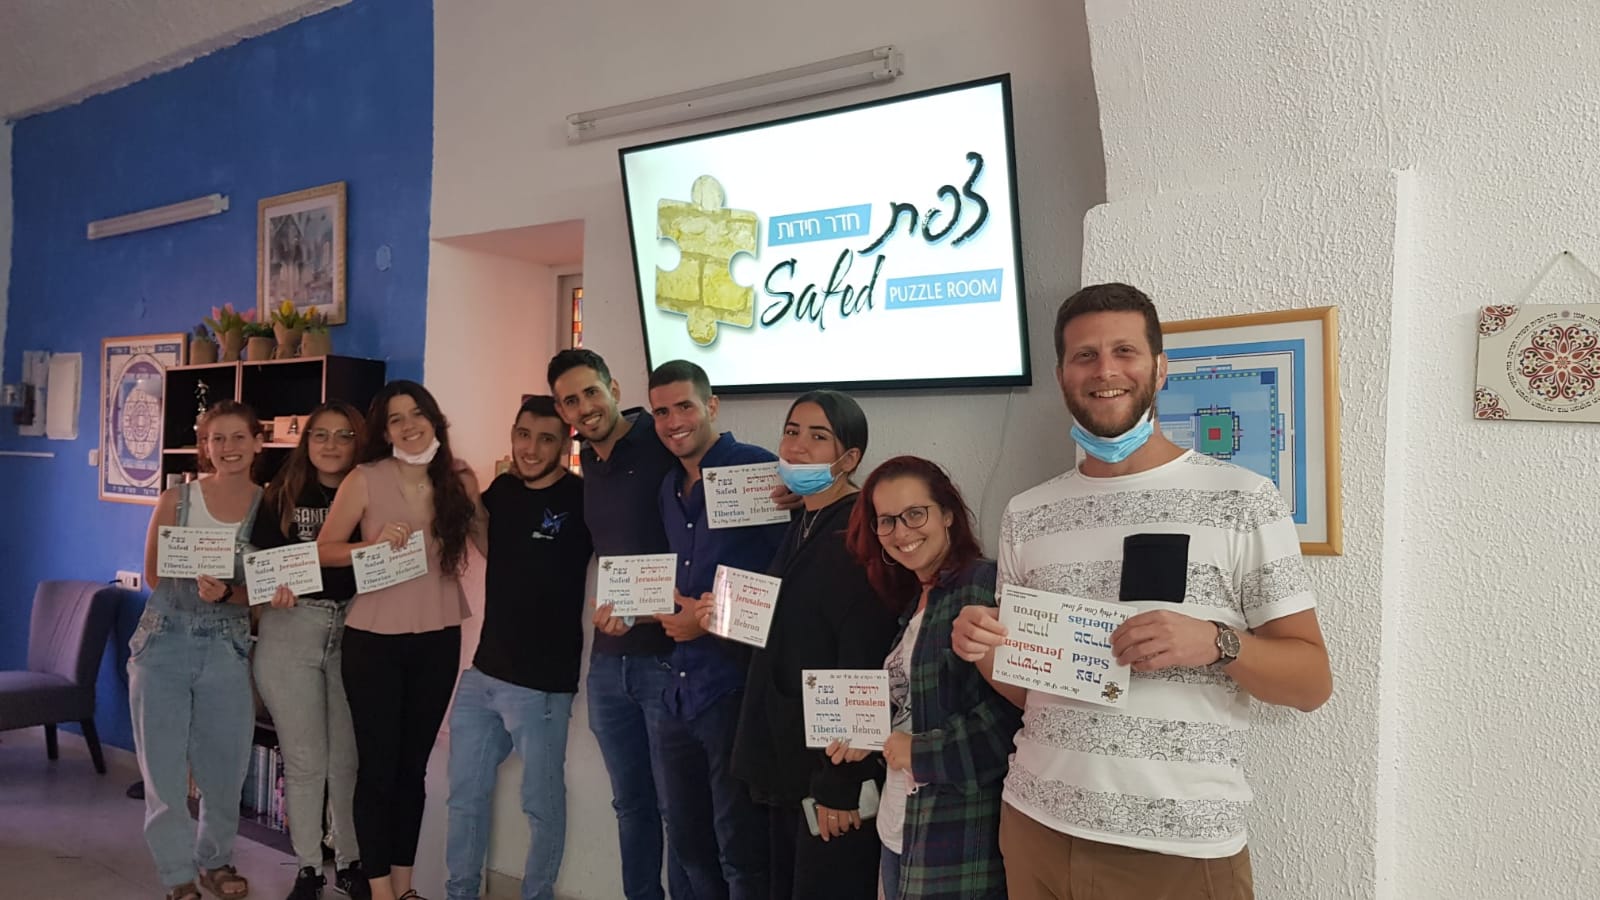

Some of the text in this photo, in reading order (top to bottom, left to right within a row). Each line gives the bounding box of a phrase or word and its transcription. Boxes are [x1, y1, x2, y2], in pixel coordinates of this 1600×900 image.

[858, 151, 988, 254] צפת
[778, 213, 861, 240] חדר חידות
[761, 248, 886, 330] Safed
[889, 278, 997, 302] PUZZLE ROOM
[715, 487, 737, 495] Safed
[713, 510, 745, 518] Tiberias
[635, 576, 672, 584] Jerusalem
[735, 593, 771, 609] Jerusalem
[1013, 605, 1059, 624] Hebron
[734, 618, 760, 631] Hebron
[1018, 621, 1049, 637] חברון
[1007, 654, 1052, 675] ירושלים
[1072, 653, 1110, 670] Safed
[1076, 669, 1103, 684] צפת
[815, 696, 839, 705] Safed
[845, 697, 886, 707] Jerusalem
[812, 724, 848, 734] Tiberias
[852, 725, 882, 735] Hebron
